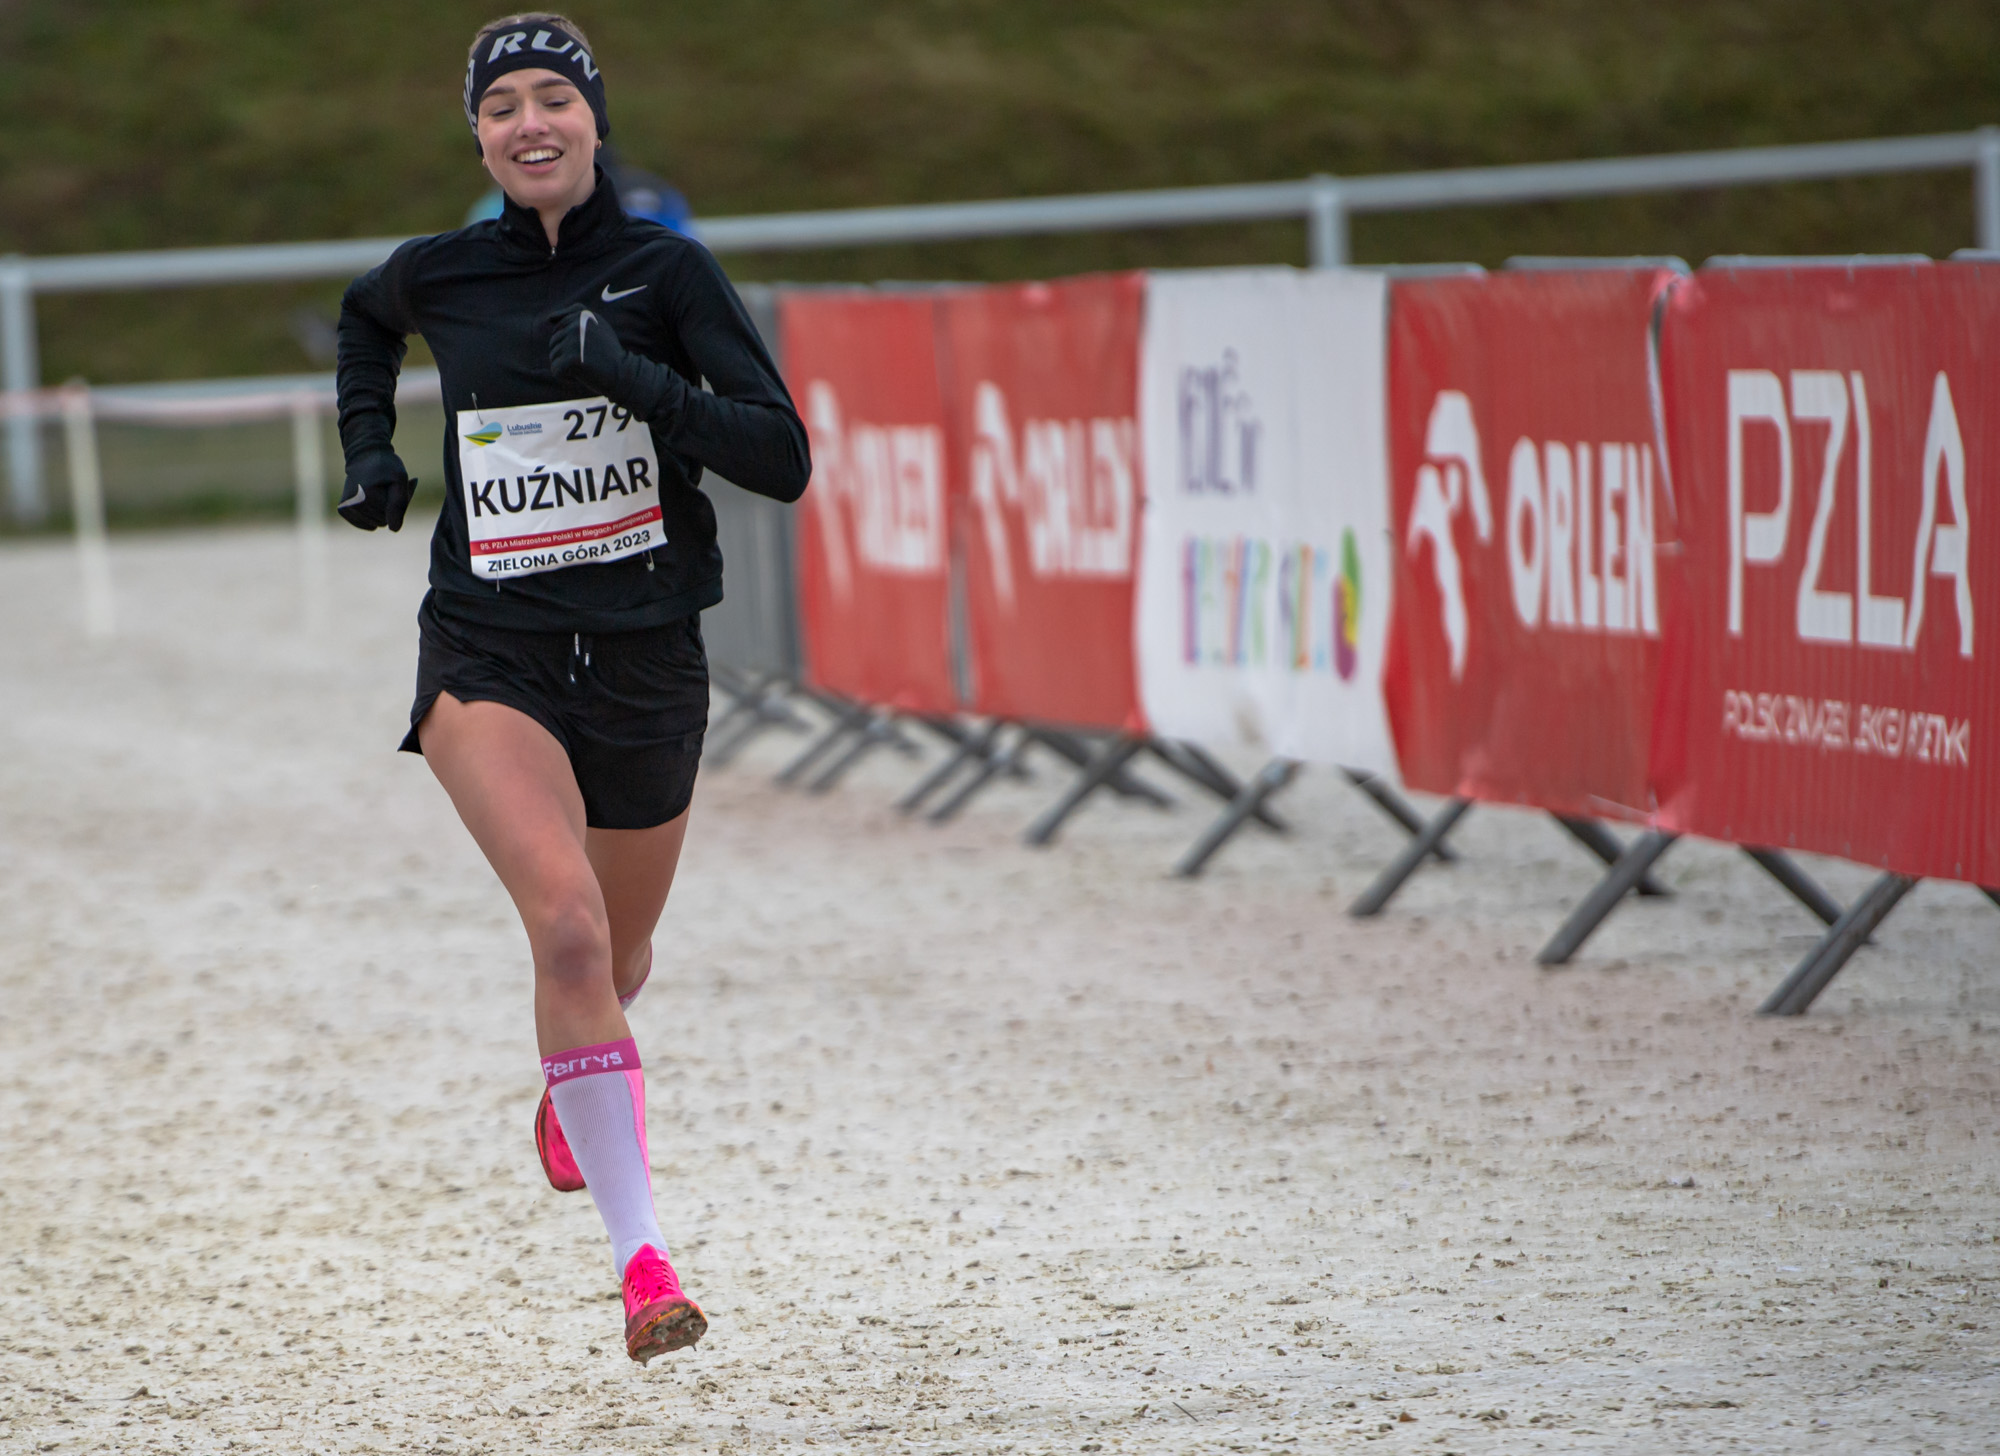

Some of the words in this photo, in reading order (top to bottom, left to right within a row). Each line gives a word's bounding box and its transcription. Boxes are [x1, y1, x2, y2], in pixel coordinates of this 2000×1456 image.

[563, 401, 633, 441] 279
[470, 457, 652, 517] KUŹNIAR
[1726, 369, 1974, 659] PZLA
[480, 542, 491, 551] 95.
[492, 541, 508, 549] PZLA
[510, 535, 551, 547] Mistrzostwa
[552, 531, 574, 541] Polski
[582, 526, 612, 538] Biegach
[488, 553, 558, 572] ZIELONA
[562, 544, 611, 562] GÓRA
[613, 529, 651, 551] 2023
[1507, 436, 1660, 637] ORLEN
[543, 1051, 624, 1081] Ferrys
